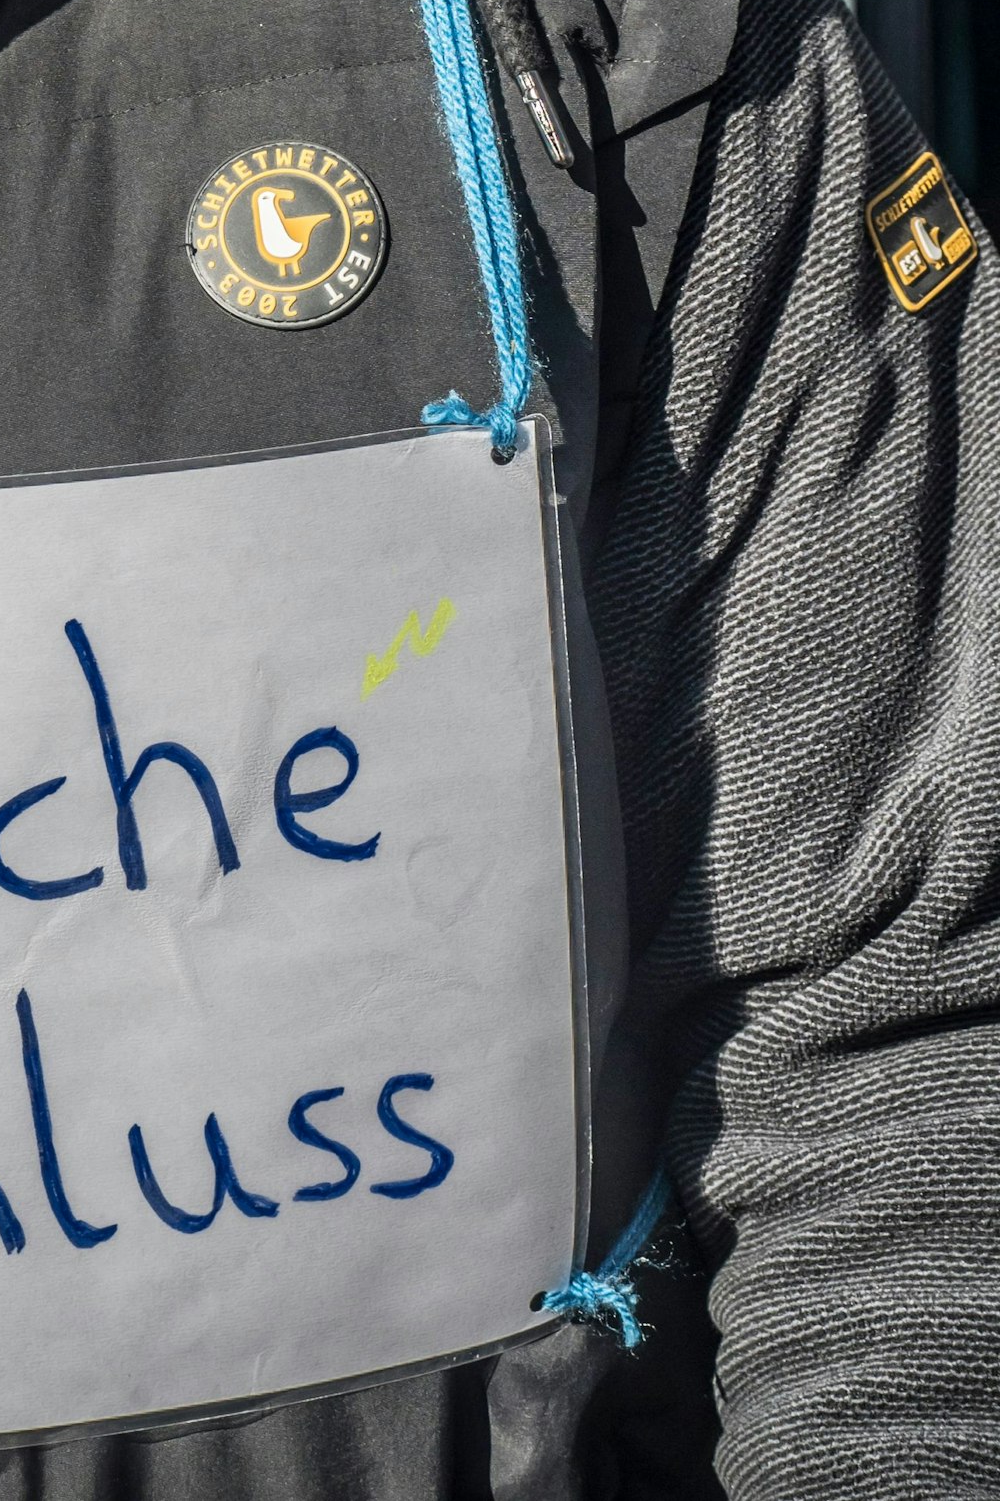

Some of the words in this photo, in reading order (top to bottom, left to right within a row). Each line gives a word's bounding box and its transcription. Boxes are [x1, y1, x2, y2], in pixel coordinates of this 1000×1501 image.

[196, 147, 375, 249] SCHIETWETTER
[324, 250, 372, 306] EST
[900, 249, 922, 275] EST
[219, 273, 299, 317] 2003
